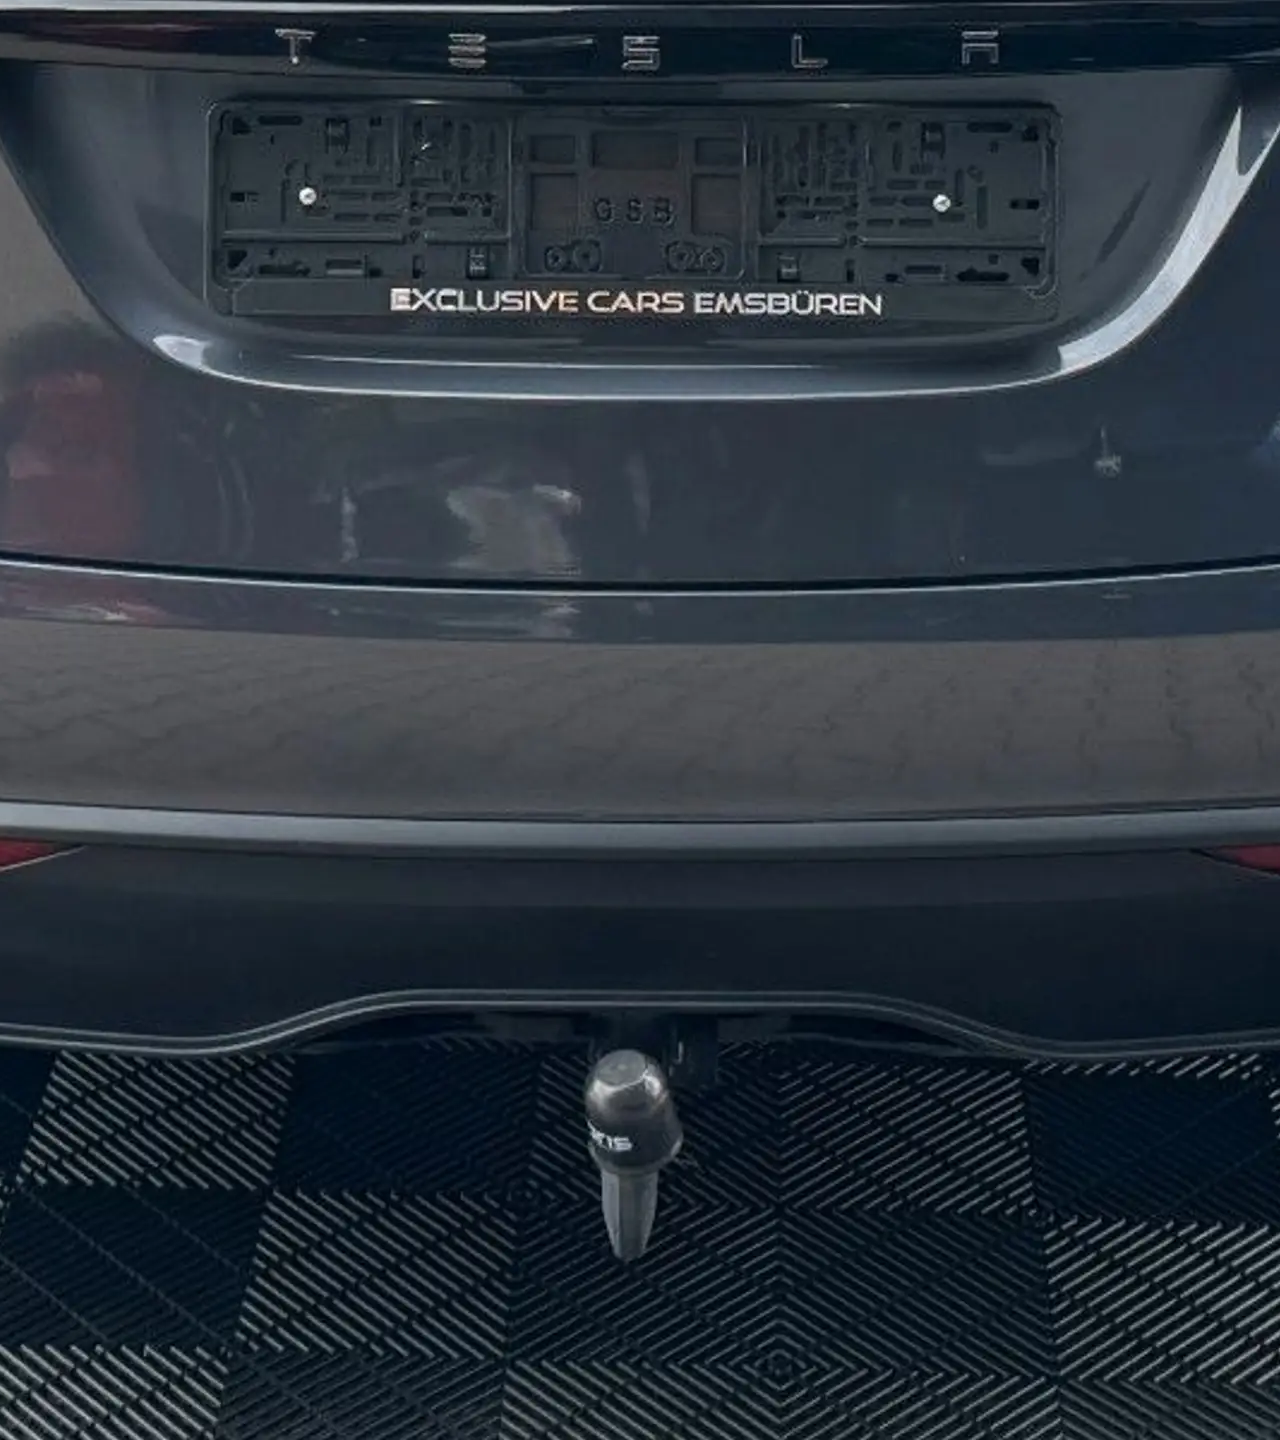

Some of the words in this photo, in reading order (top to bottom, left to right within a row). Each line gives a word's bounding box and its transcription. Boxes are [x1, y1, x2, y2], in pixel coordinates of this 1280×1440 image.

[274, 27, 1000, 70] TESLA
[389, 287, 580, 313] EXCLUSIVE
[586, 289, 685, 314] CARS
[692, 289, 883, 317] EMSBÜREN
